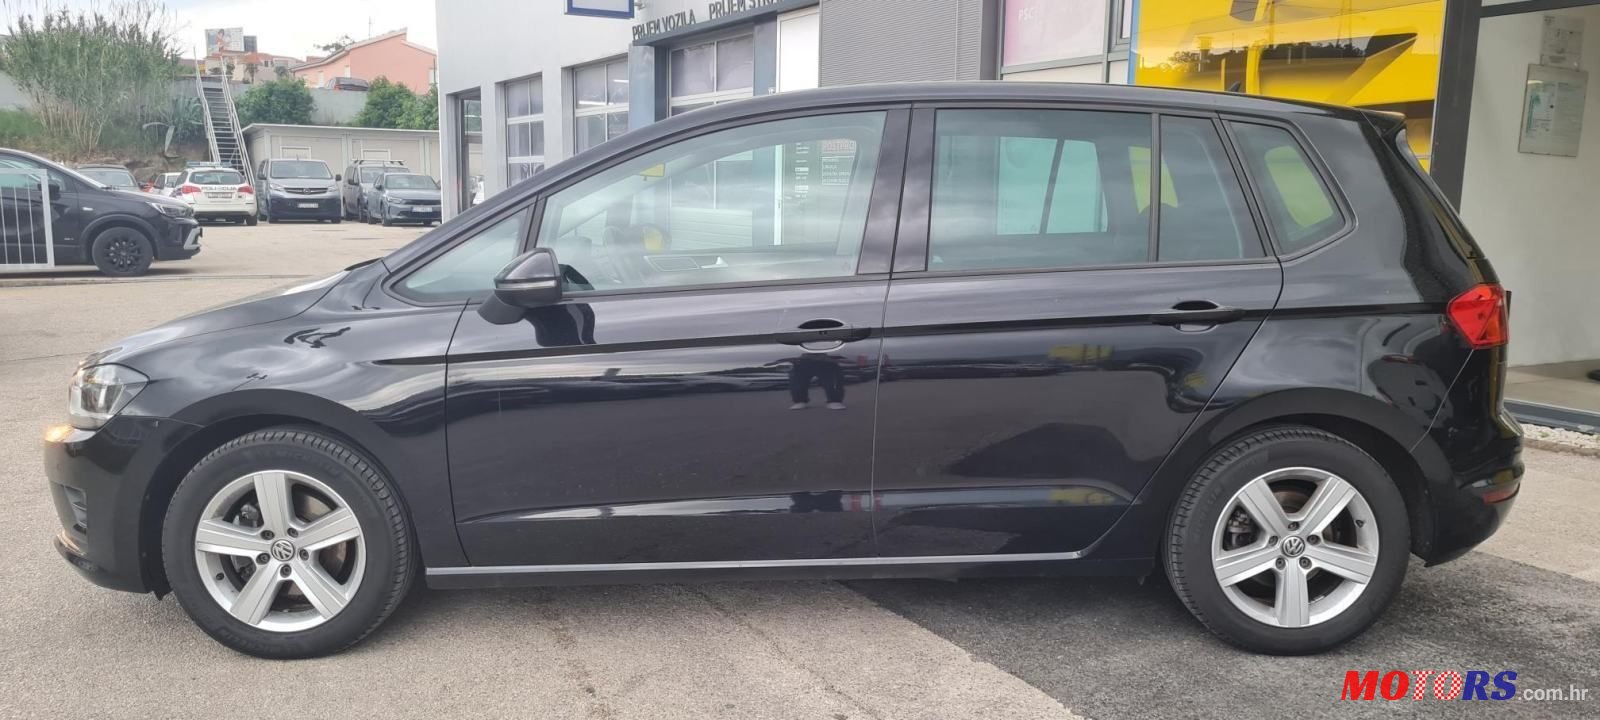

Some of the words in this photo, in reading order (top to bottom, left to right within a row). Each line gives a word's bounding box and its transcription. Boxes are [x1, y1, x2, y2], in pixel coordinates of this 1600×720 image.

[632, 18, 661, 41] PRIJEM
[662, 8, 697, 32] VOZILA
[709, 0, 746, 20] PRIJEM
